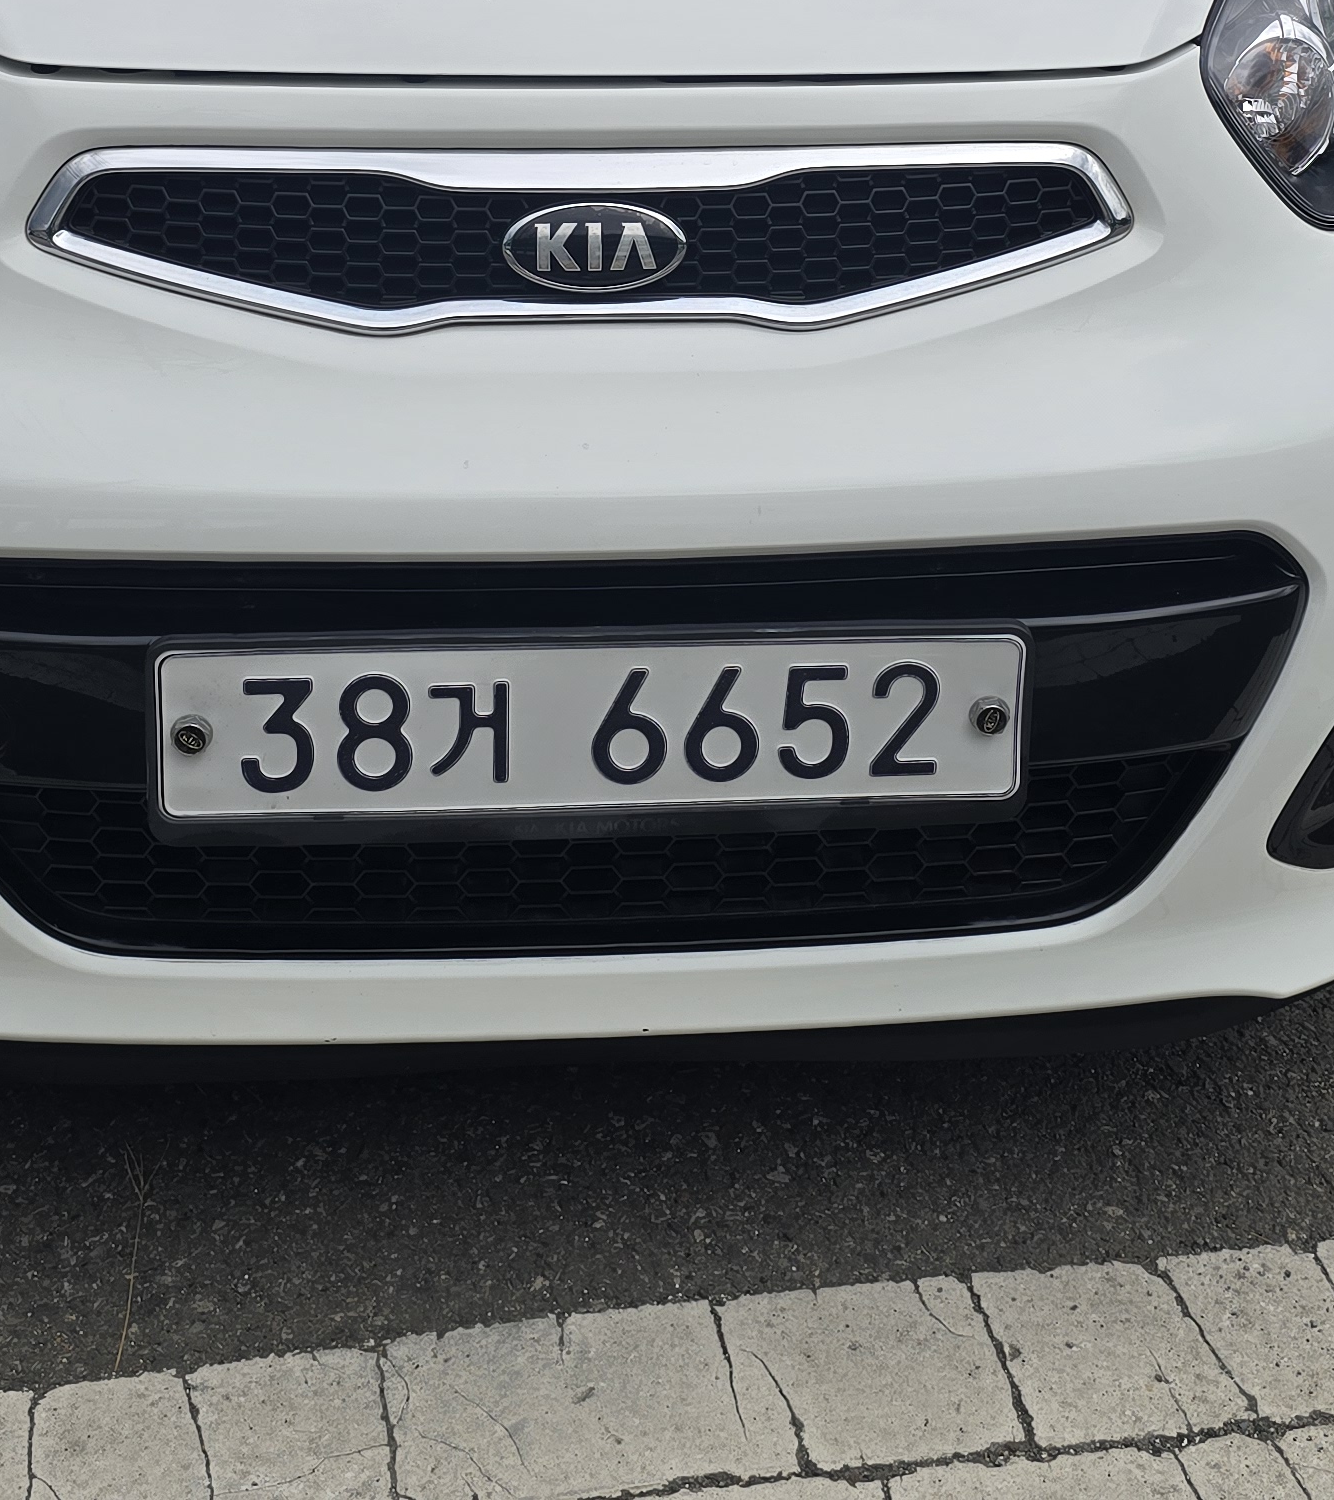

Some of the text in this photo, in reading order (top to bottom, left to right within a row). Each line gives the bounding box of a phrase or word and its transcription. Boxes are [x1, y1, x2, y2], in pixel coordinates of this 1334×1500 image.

[534, 222, 657, 272] KIA
[240, 660, 941, 794] 38거 6652
